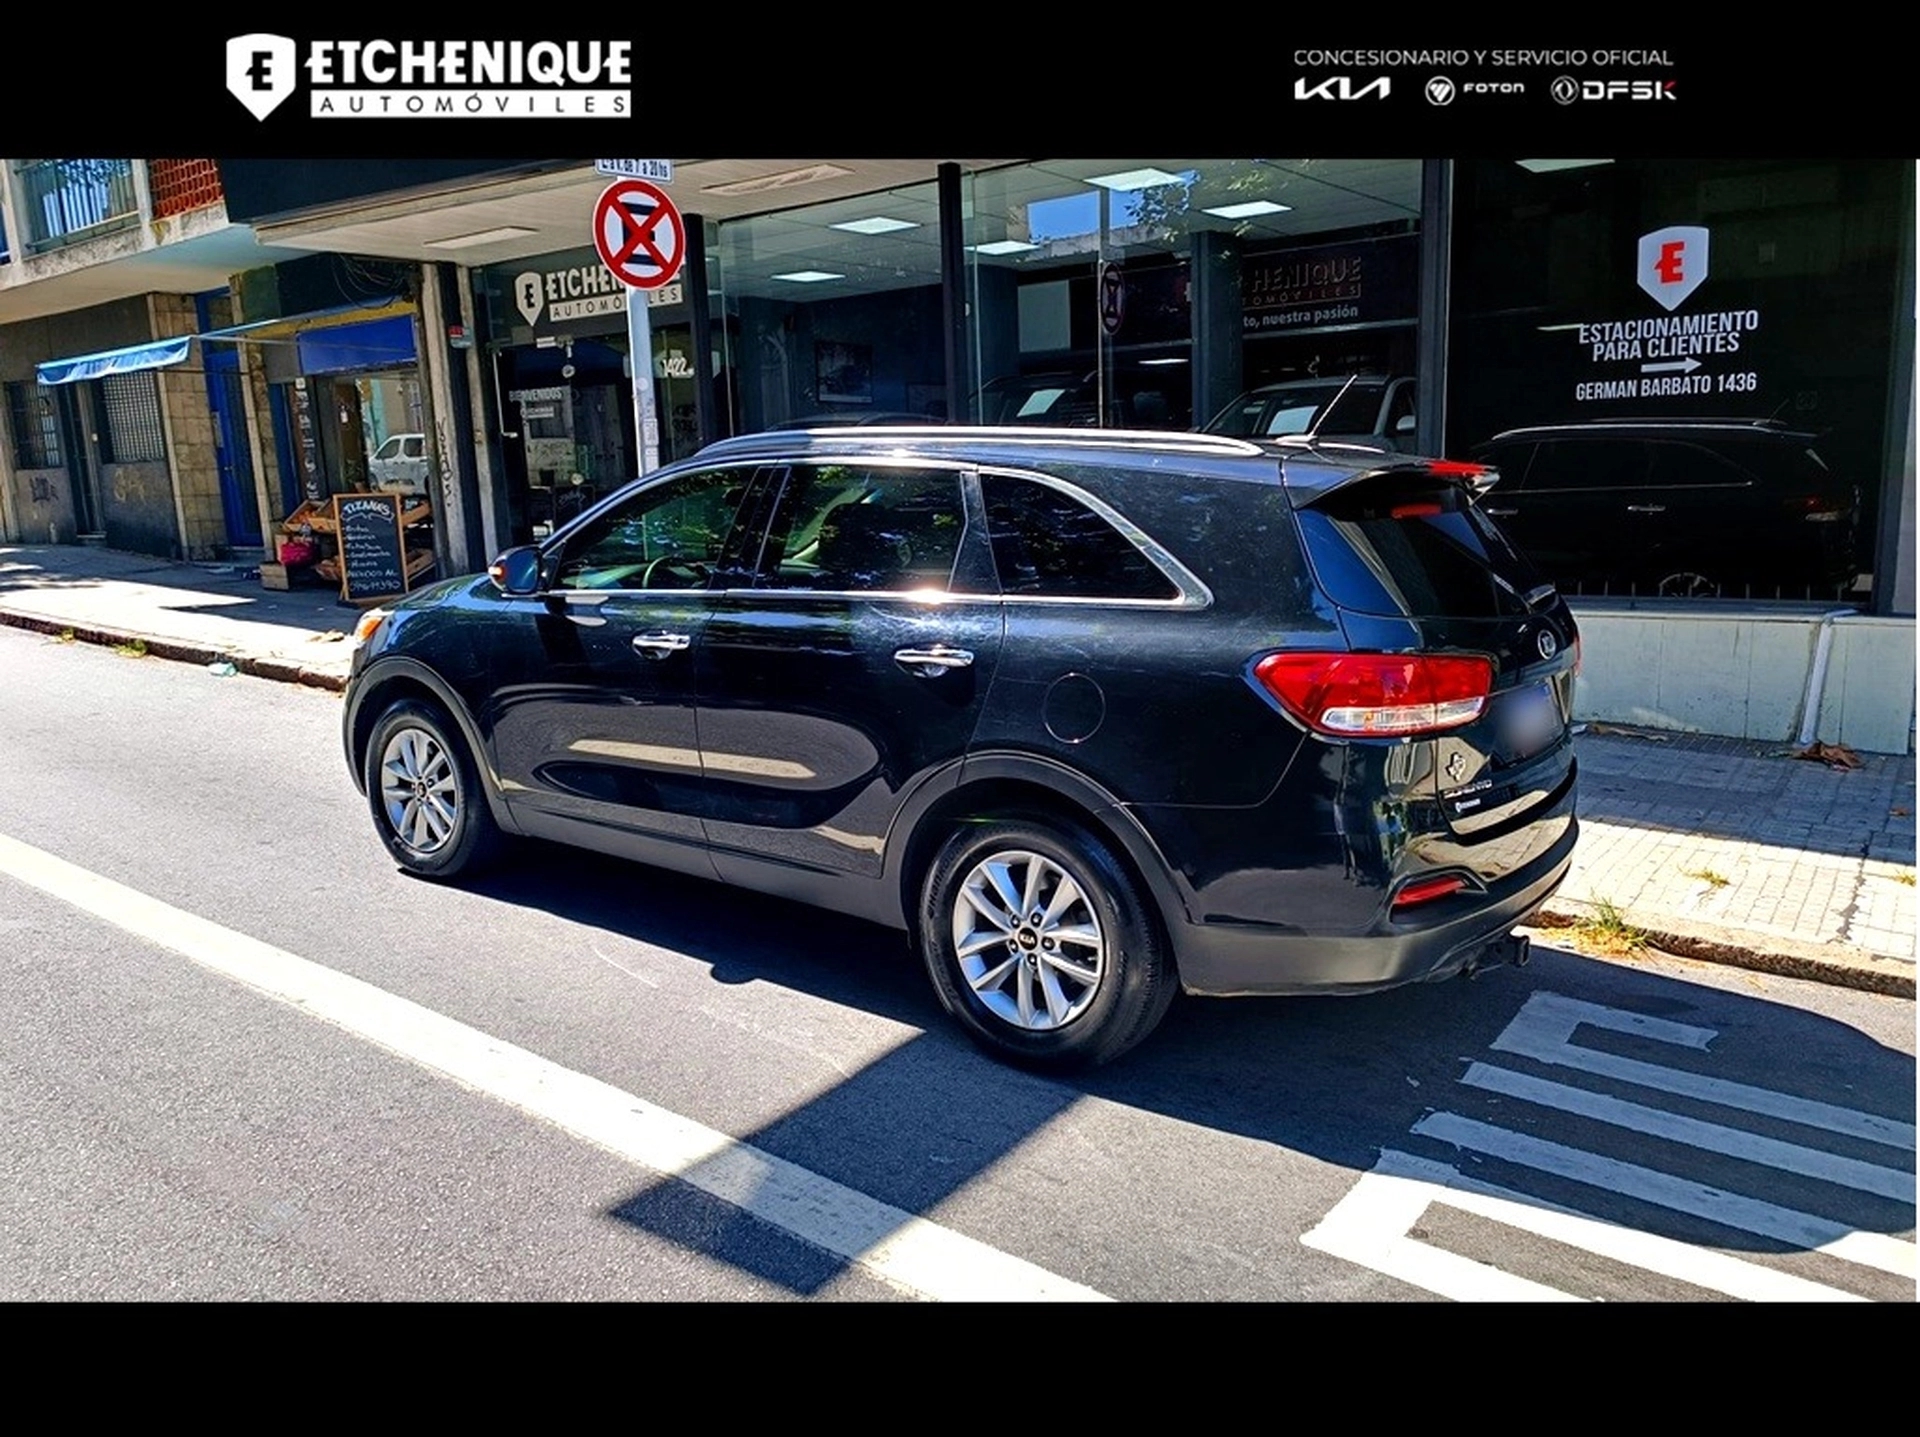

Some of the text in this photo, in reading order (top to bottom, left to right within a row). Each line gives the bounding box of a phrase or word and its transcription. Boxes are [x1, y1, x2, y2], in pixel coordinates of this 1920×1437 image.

[1252, 257, 1361, 293] HENIQUE
[1654, 241, 1685, 284] E
[545, 263, 680, 300] ETCHEN
[1242, 284, 1357, 306] TOMÓVILES
[553, 288, 677, 318] AUTOMÓLES
[1263, 309, 1311, 326] nuestra
[1314, 304, 1358, 324] pasión
[1578, 310, 1759, 344] ESTACIONAMIENTO
[1592, 332, 1740, 362] PARA CLIENTES
[661, 357, 687, 378] 1422
[1576, 372, 1757, 401] GERMAN BARBATO 1436
